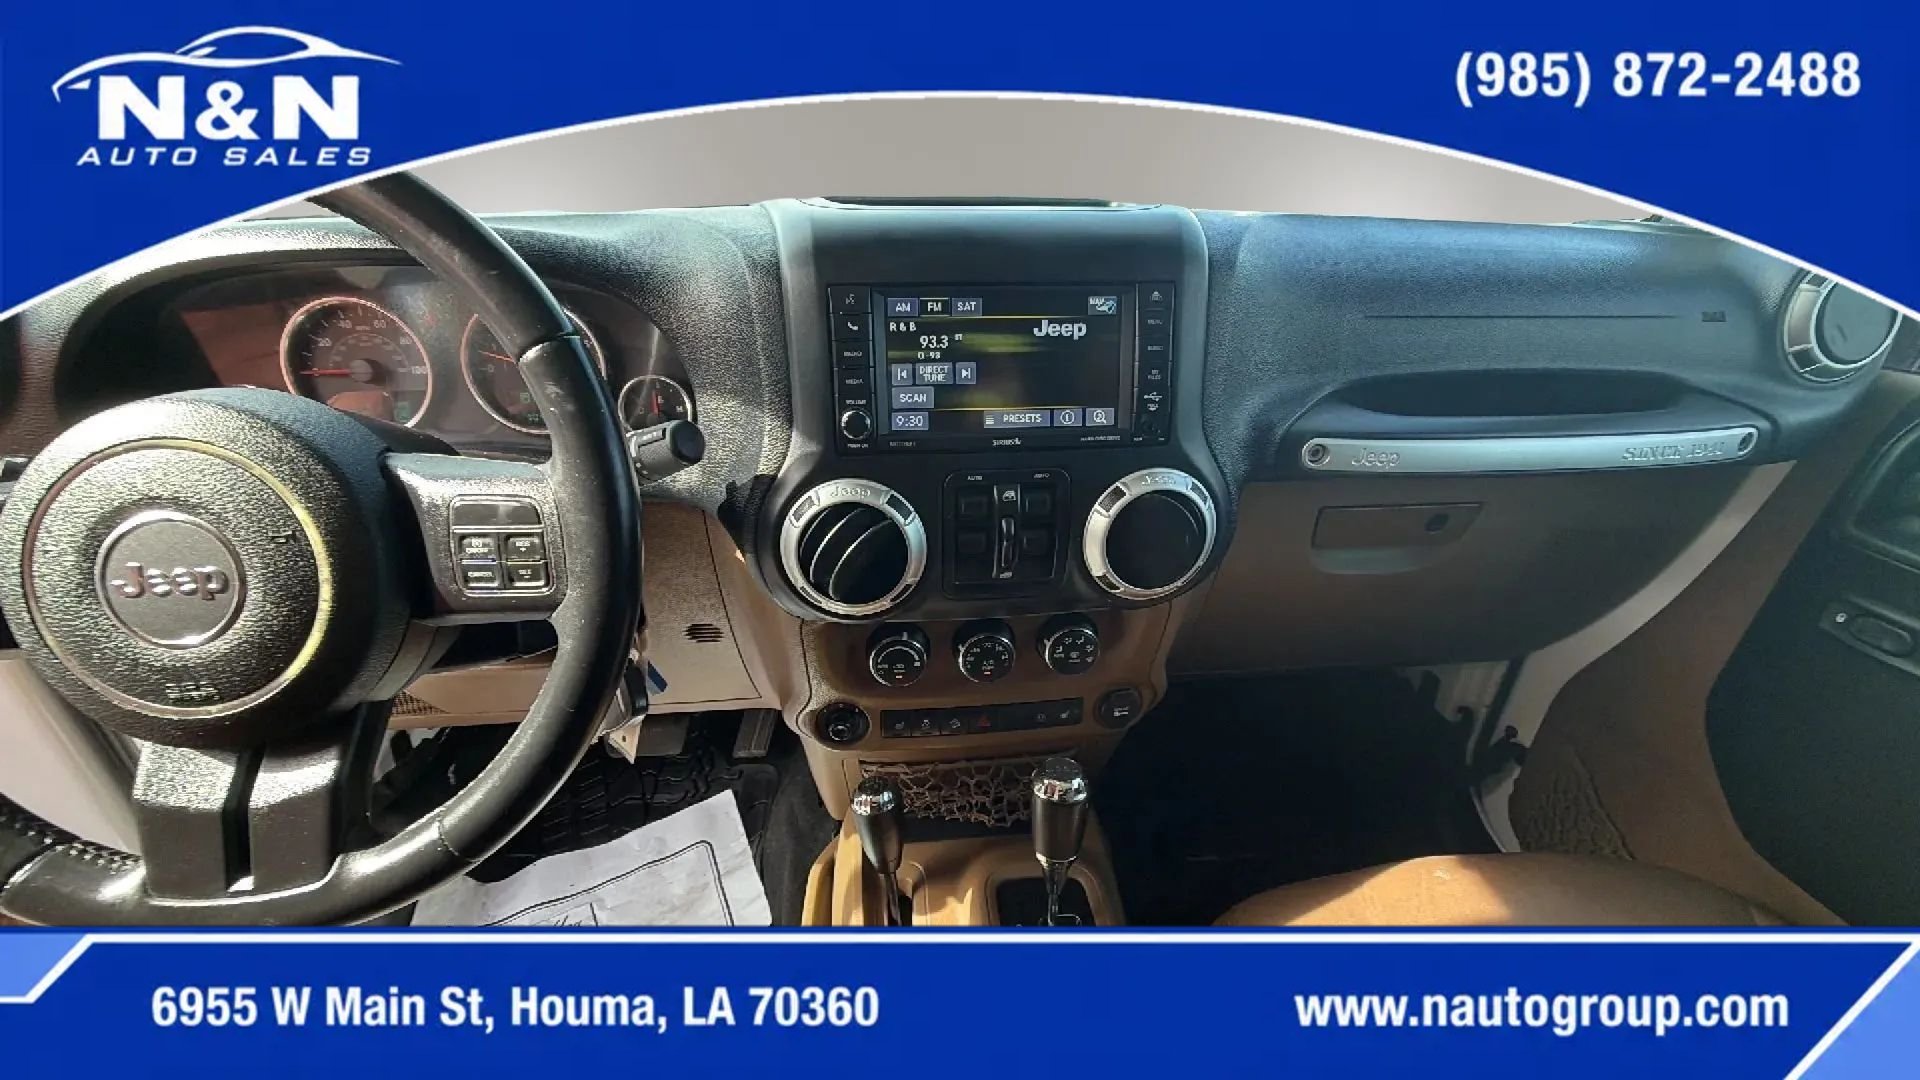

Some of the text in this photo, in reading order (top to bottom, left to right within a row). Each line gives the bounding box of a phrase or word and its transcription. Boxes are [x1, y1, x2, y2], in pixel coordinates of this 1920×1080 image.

[895, 301, 977, 312] AM FM SAT
[1033, 319, 1087, 340] Jeep
[919, 335, 949, 349] 93.3
[919, 365, 949, 375] DIRECT
[923, 374, 947, 383] TUNE
[899, 393, 927, 403] SCAN
[896, 415, 924, 427] 9:30
[1003, 413, 1043, 424] PRESETS
[1351, 447, 1400, 469] Jeep
[830, 485, 871, 499] Jeep
[109, 561, 230, 601] Jeep
